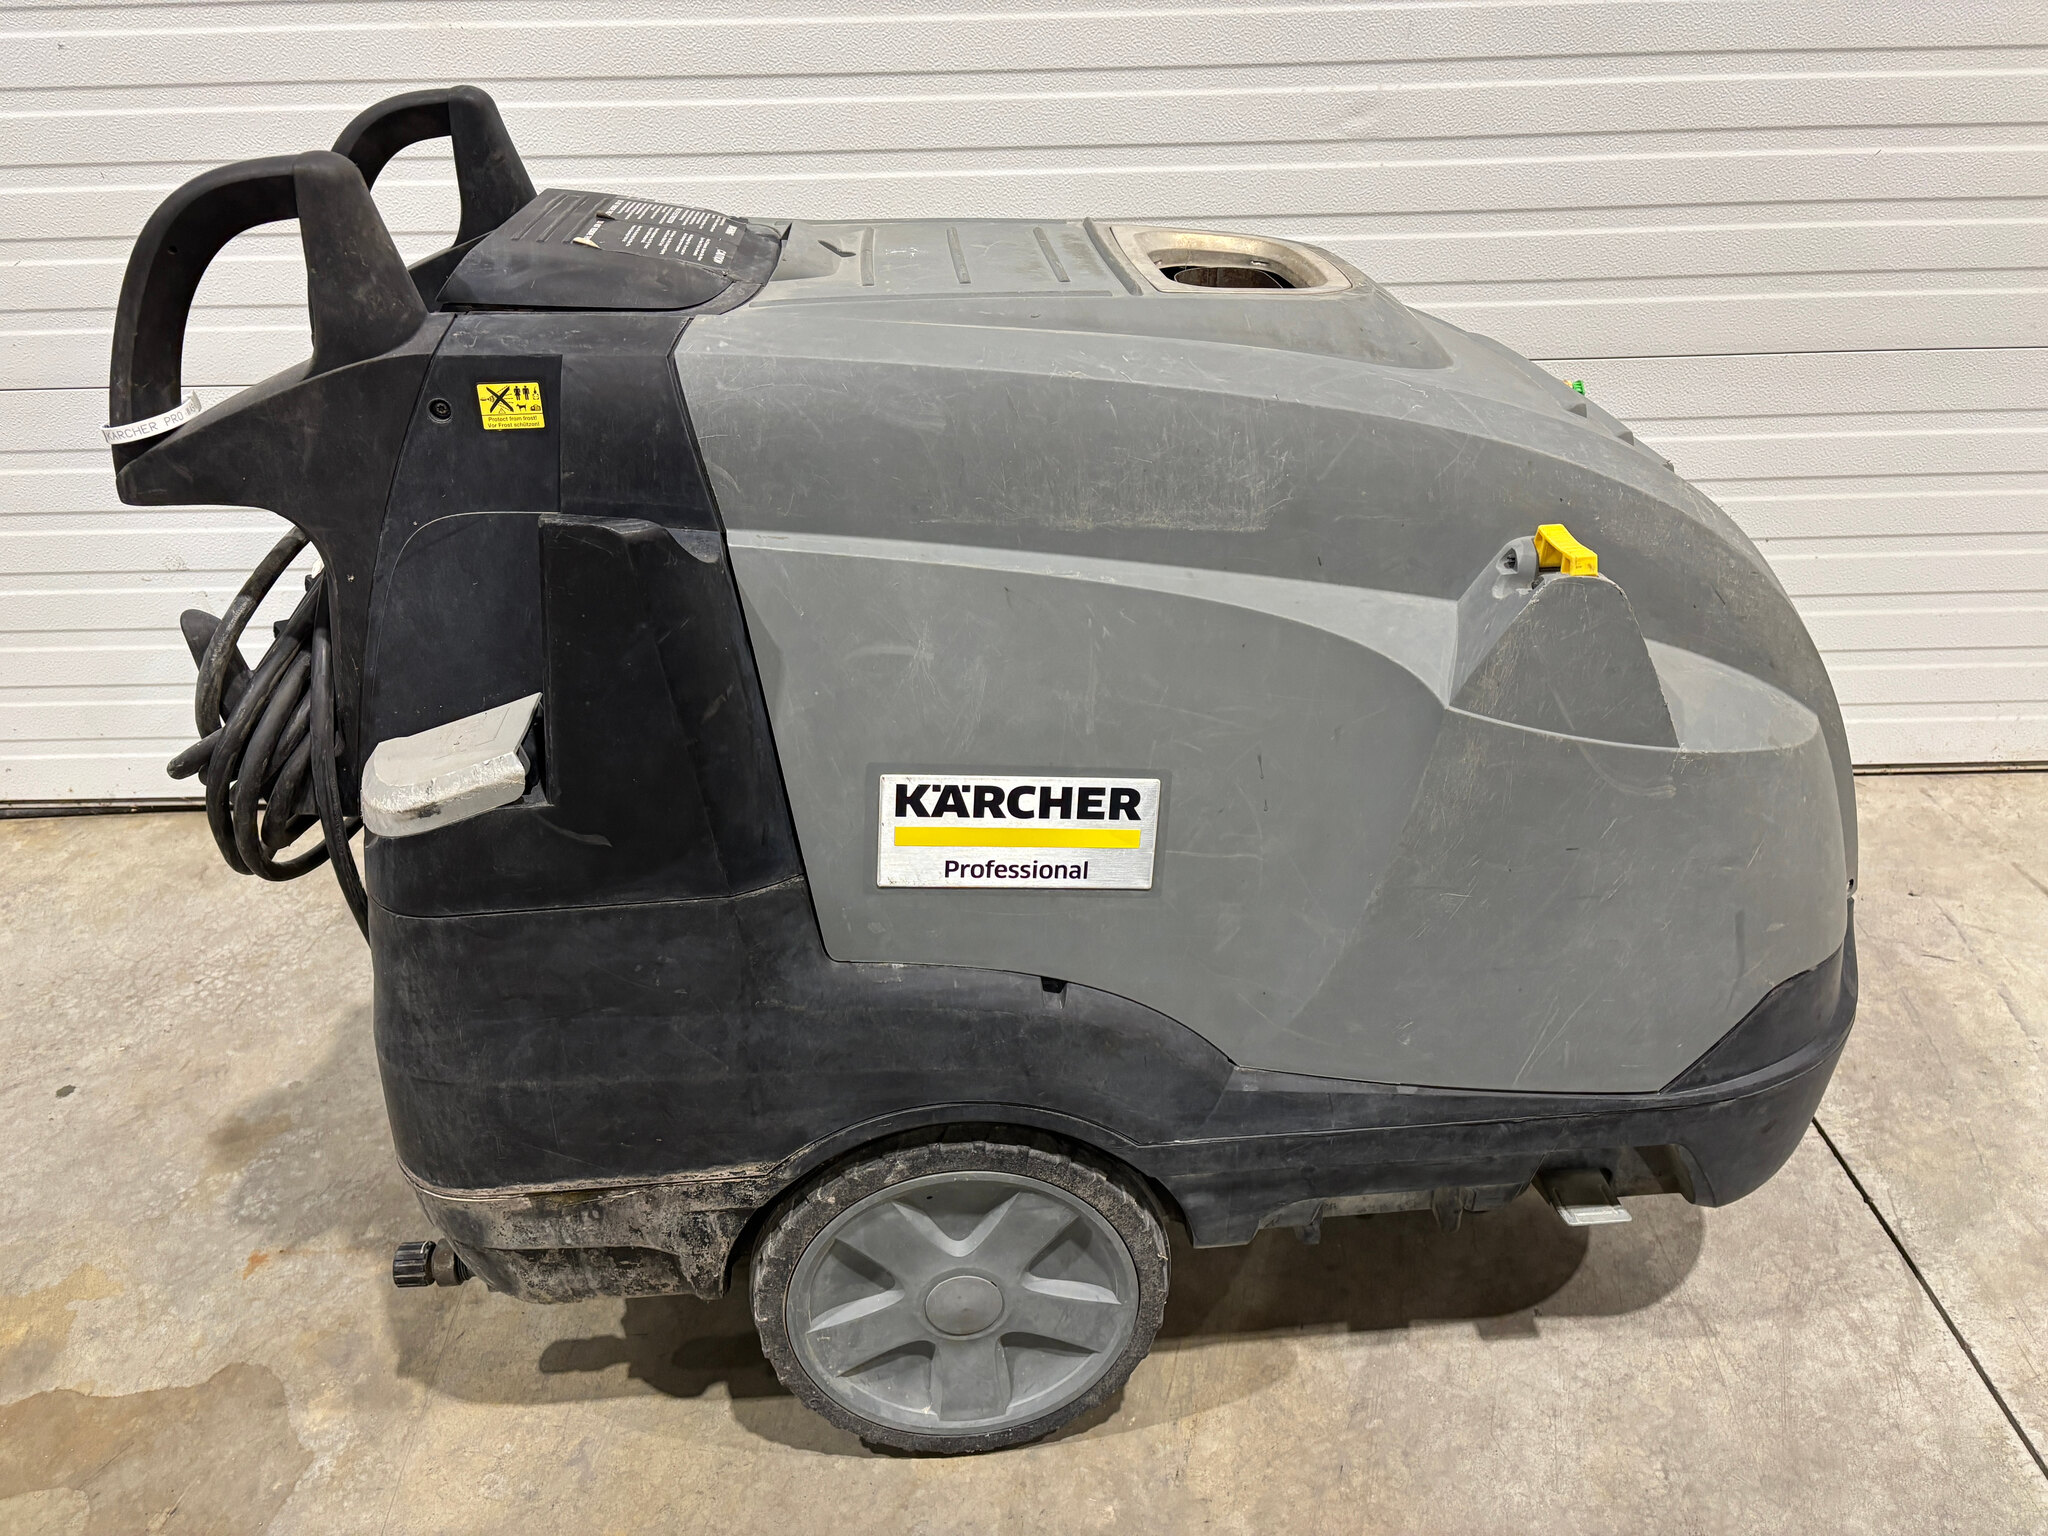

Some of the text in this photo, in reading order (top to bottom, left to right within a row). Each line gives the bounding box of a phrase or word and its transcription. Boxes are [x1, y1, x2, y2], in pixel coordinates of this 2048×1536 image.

[106, 411, 184, 441] KARCHER PRO
[895, 783, 1142, 821] KÄRCHER
[944, 860, 1089, 880] Professional
